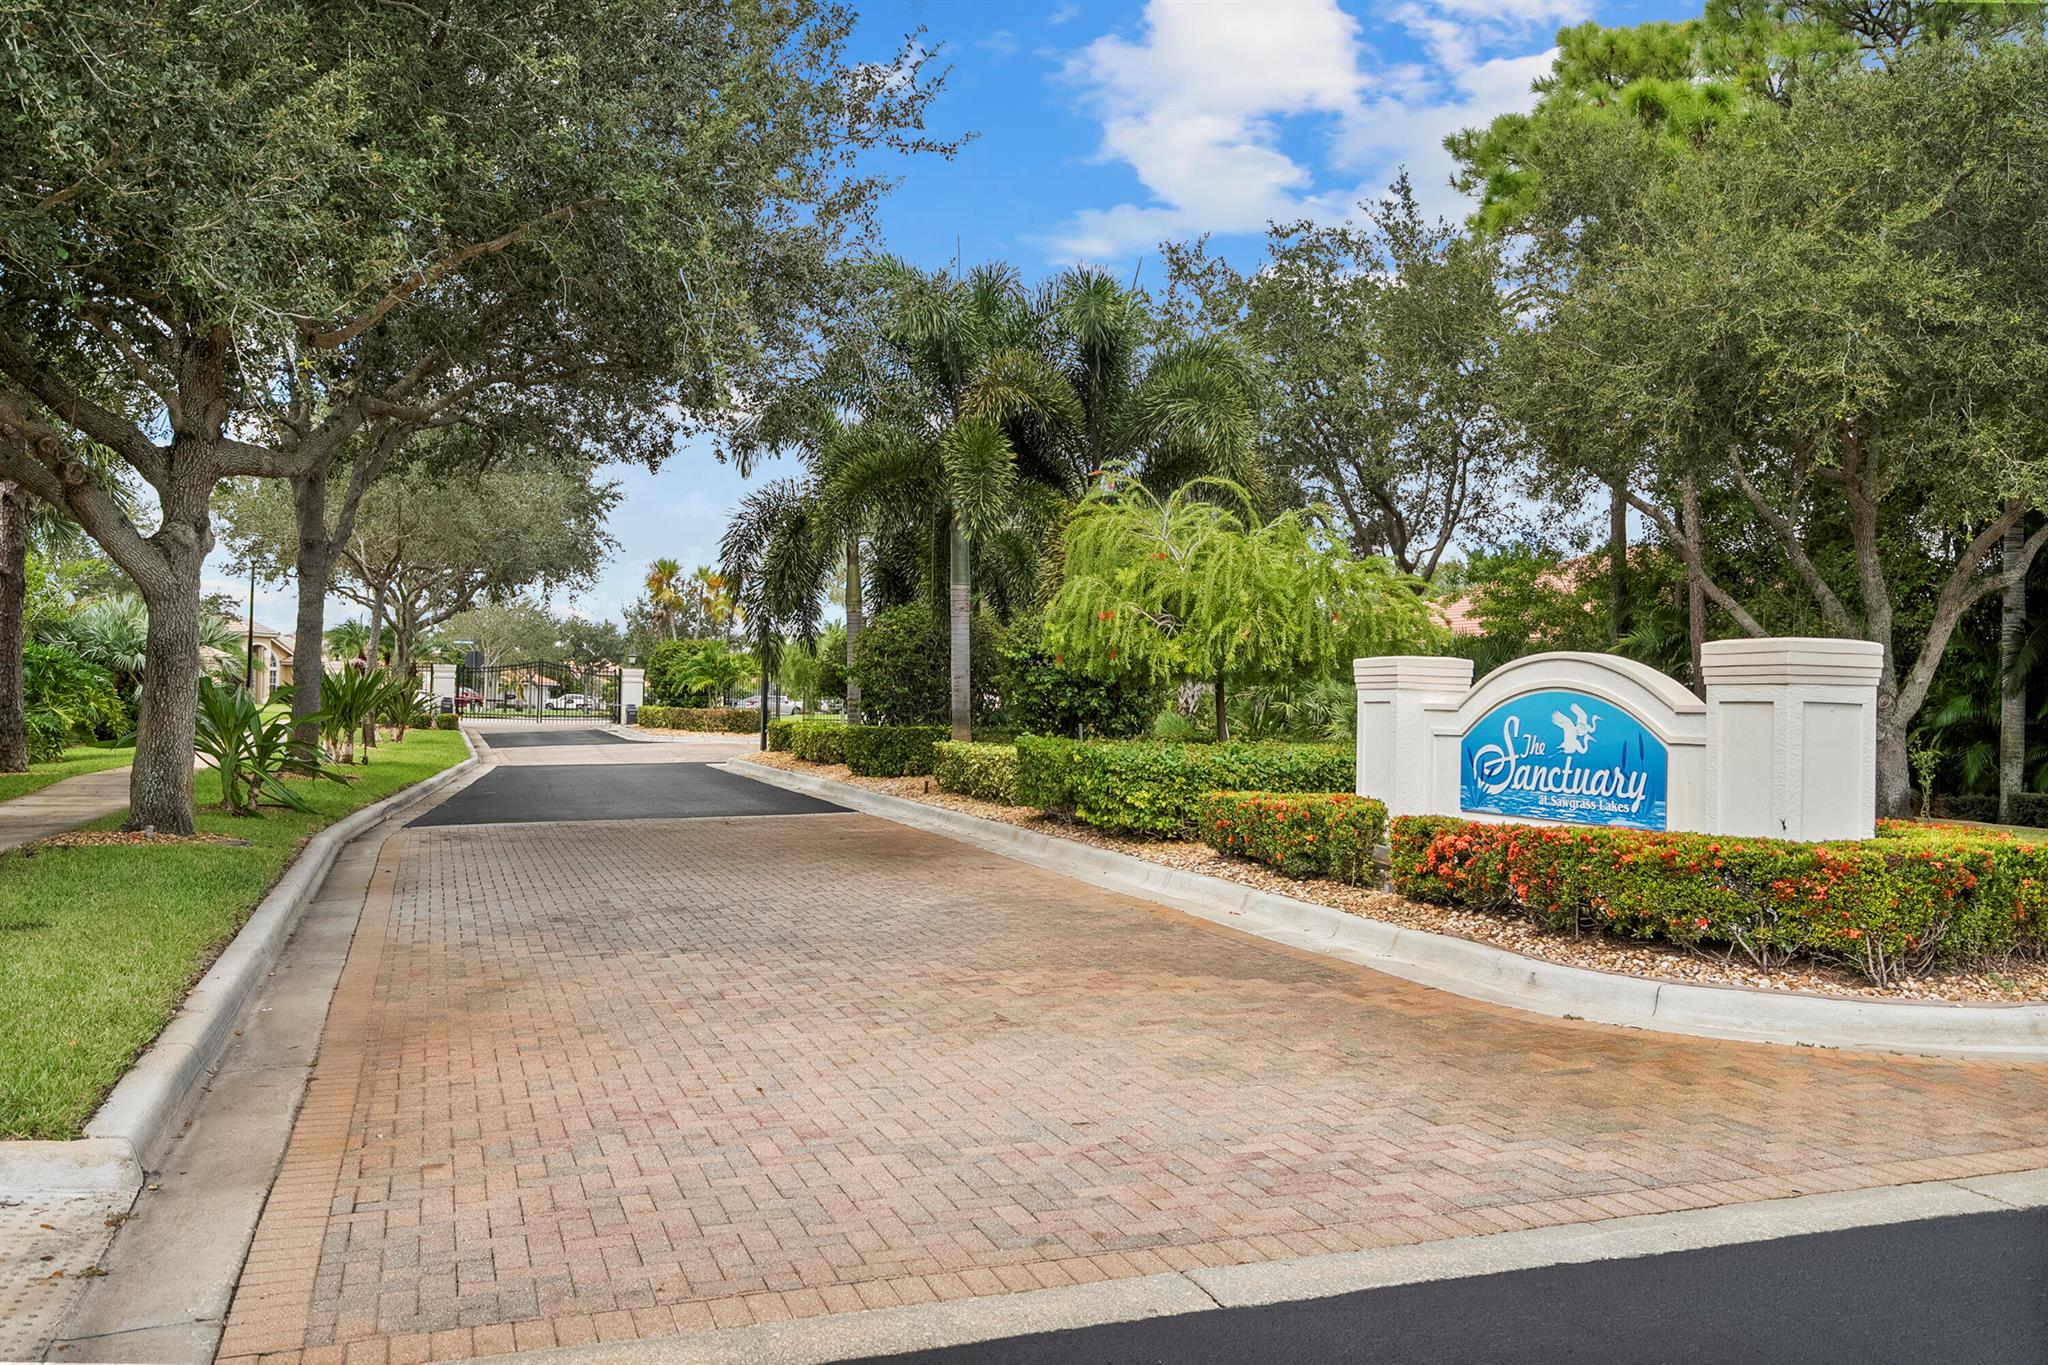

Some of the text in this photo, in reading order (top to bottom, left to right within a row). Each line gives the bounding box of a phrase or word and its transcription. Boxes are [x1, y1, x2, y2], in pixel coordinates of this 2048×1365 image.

[1520, 734, 1546, 758] The
[1473, 715, 1648, 813] Sanctuary
[1538, 795, 1631, 813] at Sawgrass Lakes
